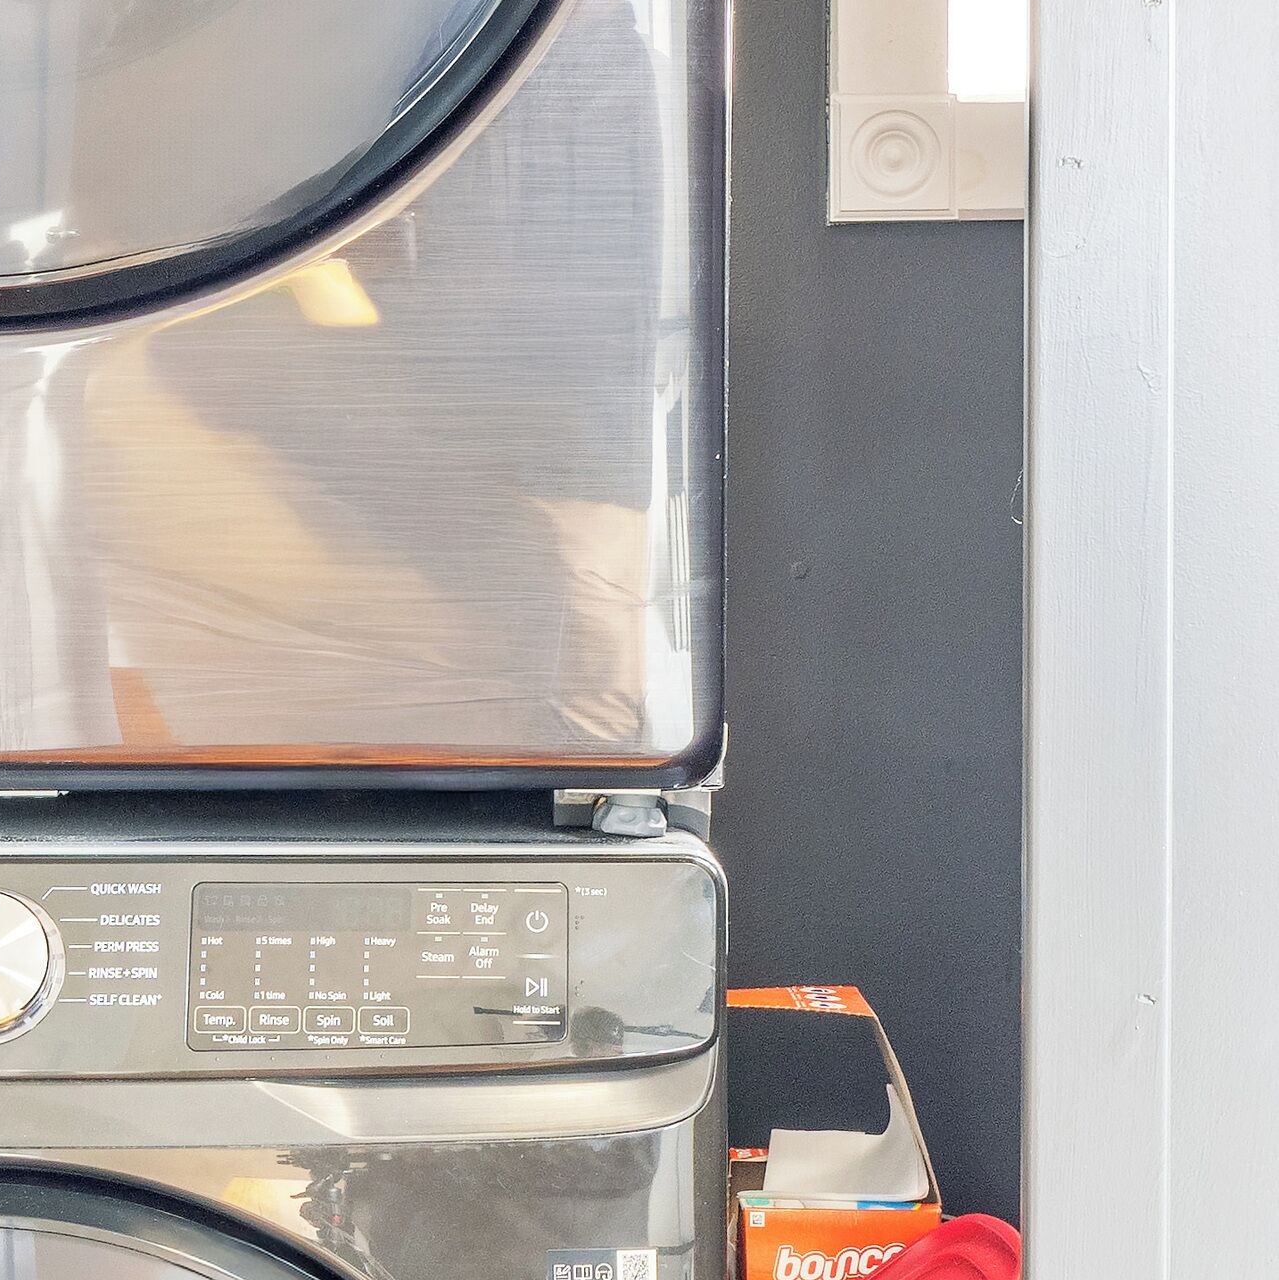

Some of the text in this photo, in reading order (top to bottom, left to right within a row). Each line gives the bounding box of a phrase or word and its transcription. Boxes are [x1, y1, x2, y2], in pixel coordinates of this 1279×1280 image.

[91, 883, 161, 896] QUICK WASH
[430, 903, 448, 912] Pre
[471, 903, 499, 915] Delay
[100, 915, 160, 926] DELICATES
[426, 915, 451, 925] Soak
[475, 915, 494, 925] End
[207, 937, 223, 945] Hot
[268, 937, 292, 945] times
[316, 937, 336, 946] High
[371, 937, 396, 947] Heavy
[94, 941, 159, 952] PERM PRESS
[469, 946, 499, 957] Alarm
[421, 952, 454, 962] Steam
[475, 958, 493, 969] Off
[89, 994, 118, 1005] SELF
[205, 991, 225, 1000] Cold
[266, 991, 286, 1000] time
[315, 991, 347, 1002] No Spin
[369, 991, 391, 1002] Light
[514, 1006, 531, 1014] Hold
[541, 1006, 560, 1014] Start
[203, 1014, 236, 1027] Temp.
[259, 1014, 290, 1025] Rinse
[317, 1015, 341, 1027] Spin
[373, 1015, 394, 1026] Soil
[249, 1036, 266, 1044] Lock
[329, 1036, 348, 1046] Only
[389, 1037, 406, 1045] Care
